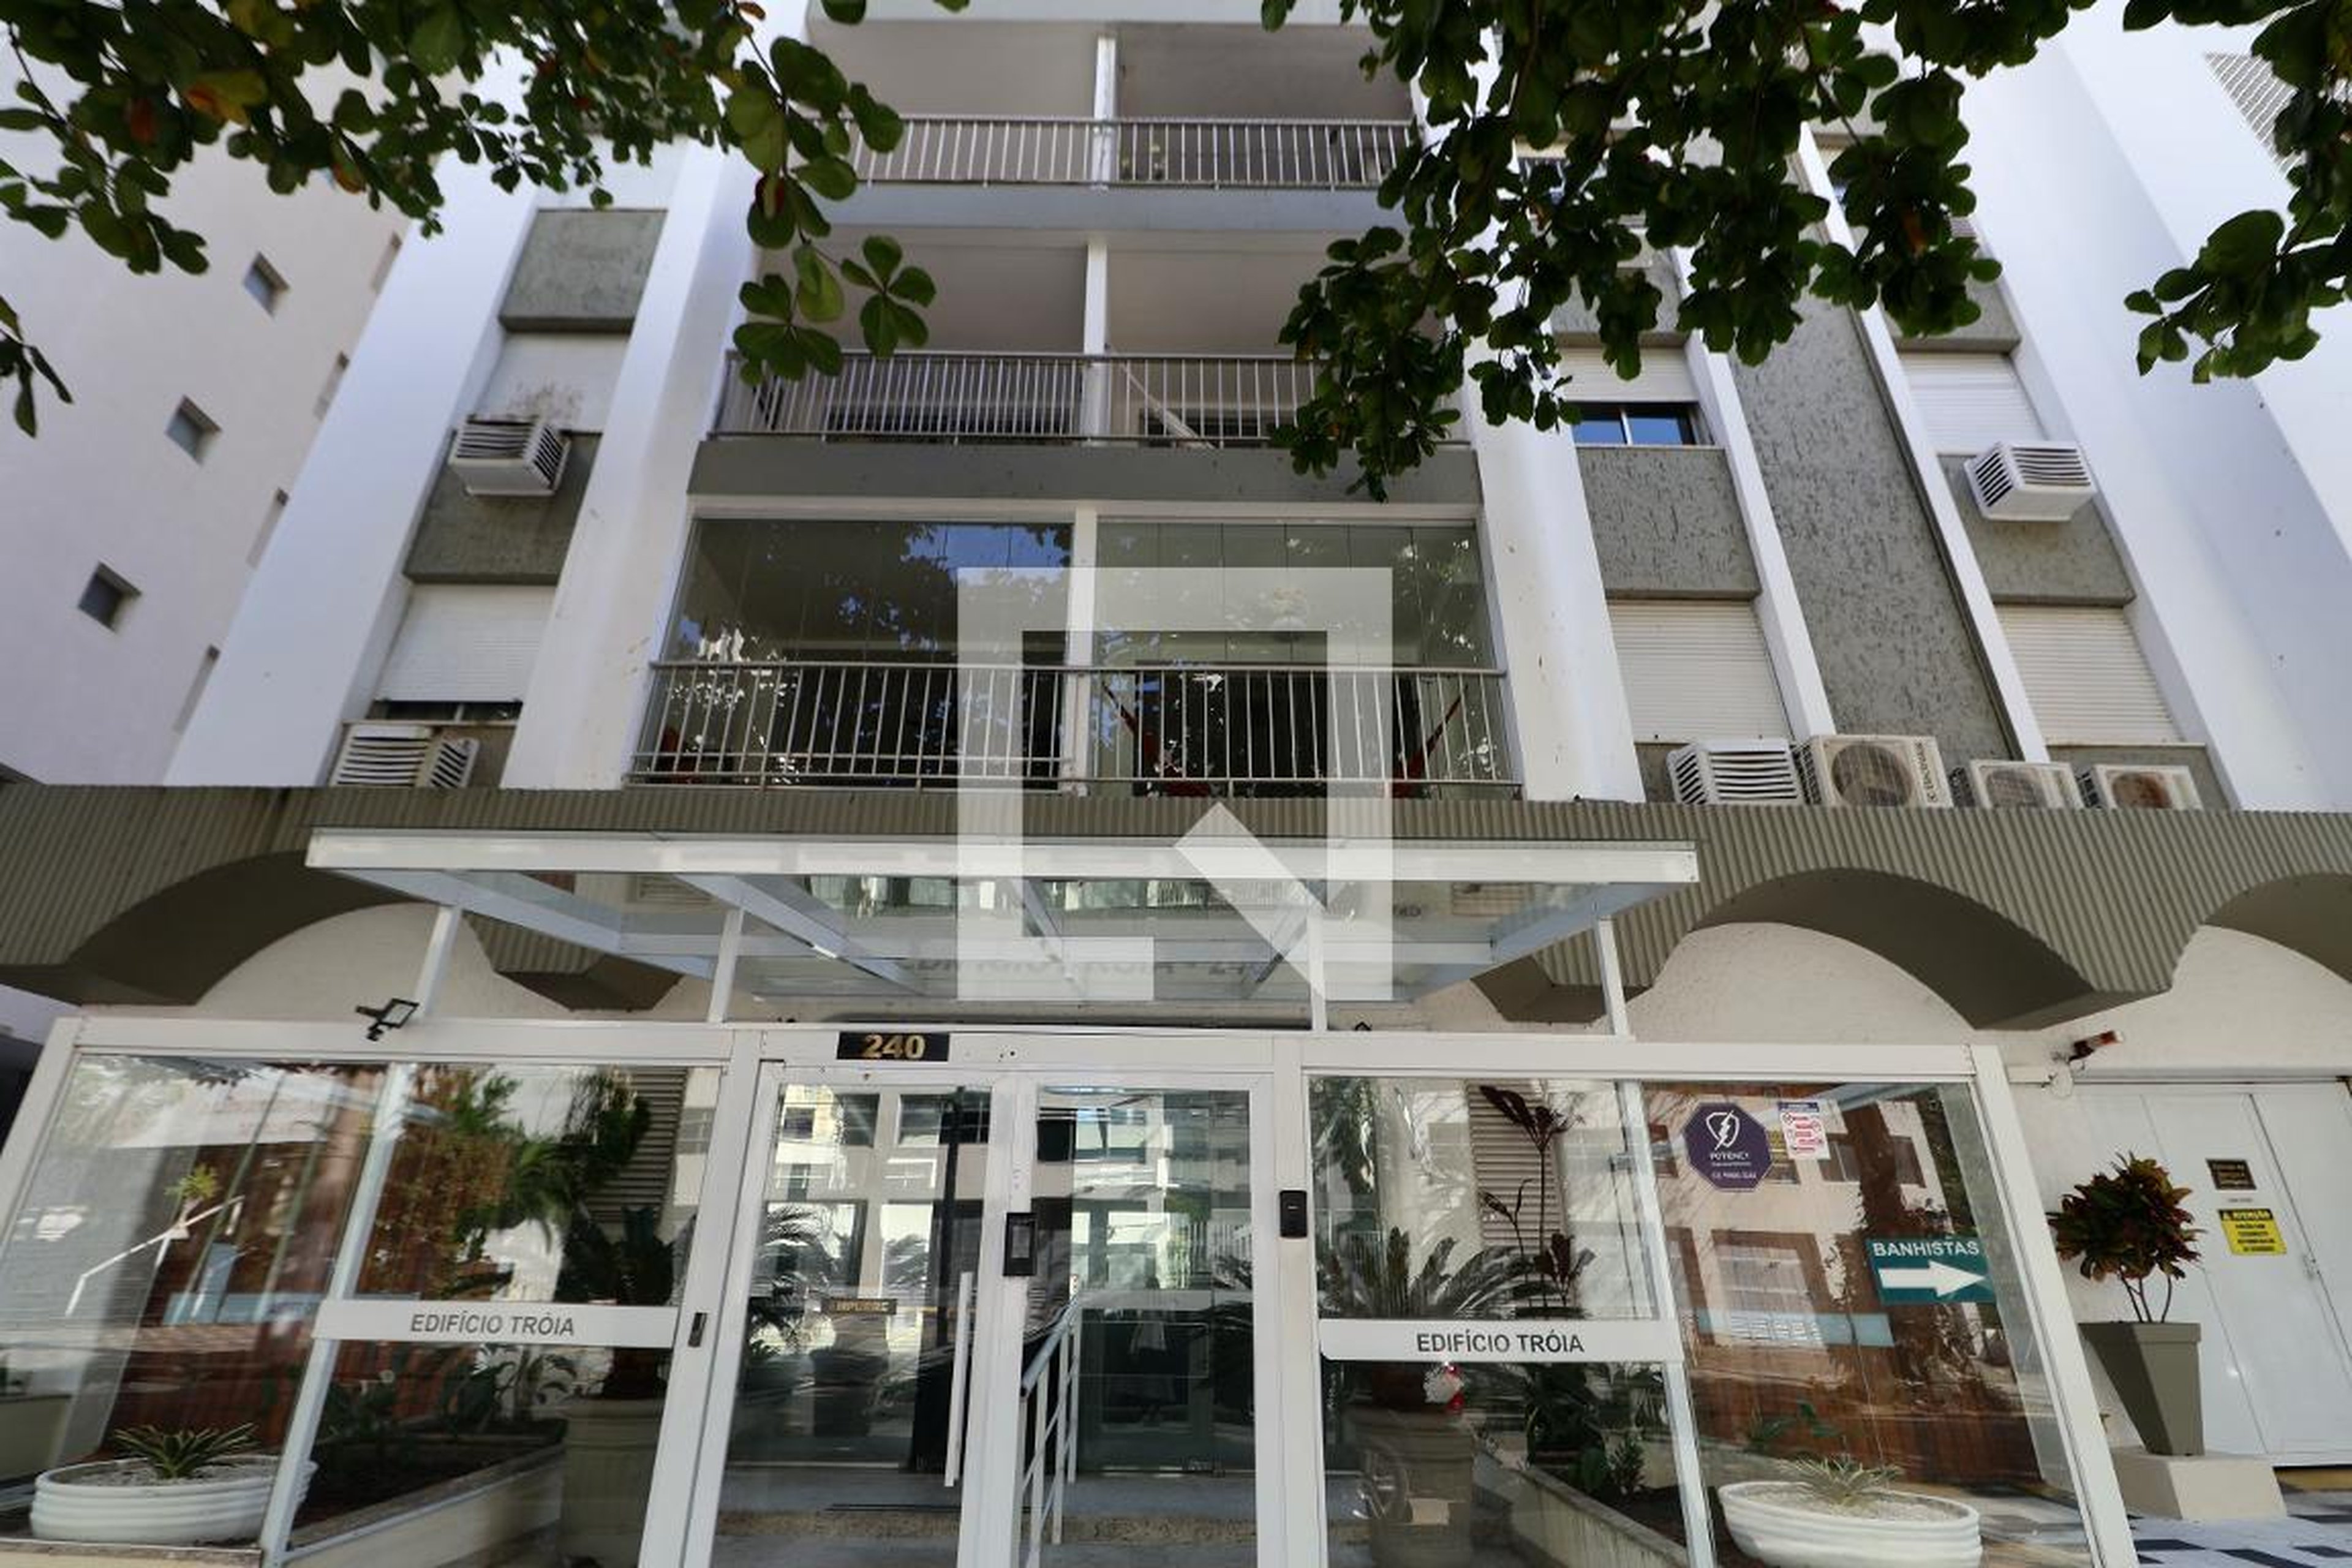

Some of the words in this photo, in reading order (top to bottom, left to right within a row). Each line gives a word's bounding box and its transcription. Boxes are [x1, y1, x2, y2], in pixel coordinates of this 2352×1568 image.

[862, 1035, 925, 1058] 240
[1872, 1241, 1980, 1256] BANHISTAS
[410, 1310, 503, 1334] EDIFÍCIO
[511, 1311, 575, 1336] TRÓIA
[1416, 1328, 1510, 1353] EDIFÍCIO
[1516, 1329, 1585, 1353] TRÓIA
